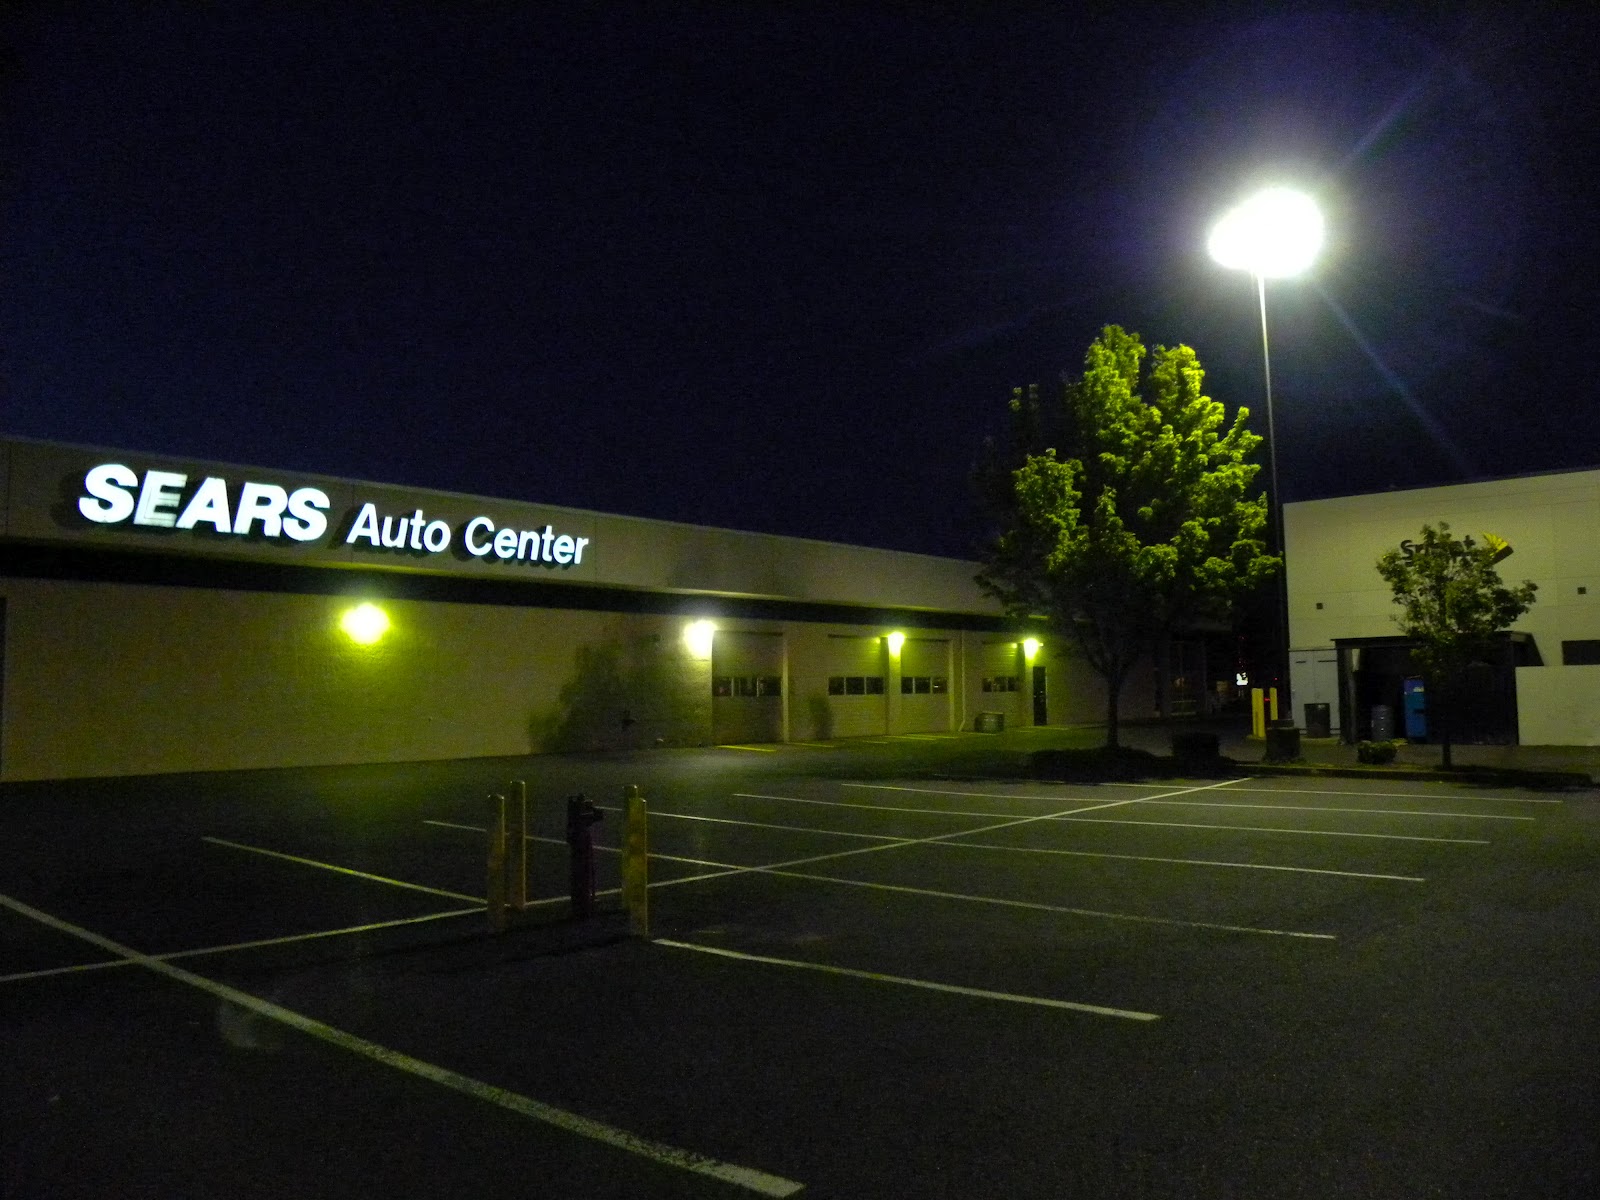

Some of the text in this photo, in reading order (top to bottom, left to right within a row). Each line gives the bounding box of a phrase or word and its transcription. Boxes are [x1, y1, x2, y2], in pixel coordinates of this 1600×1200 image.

[78, 463, 590, 565] SEARS Auto Center
